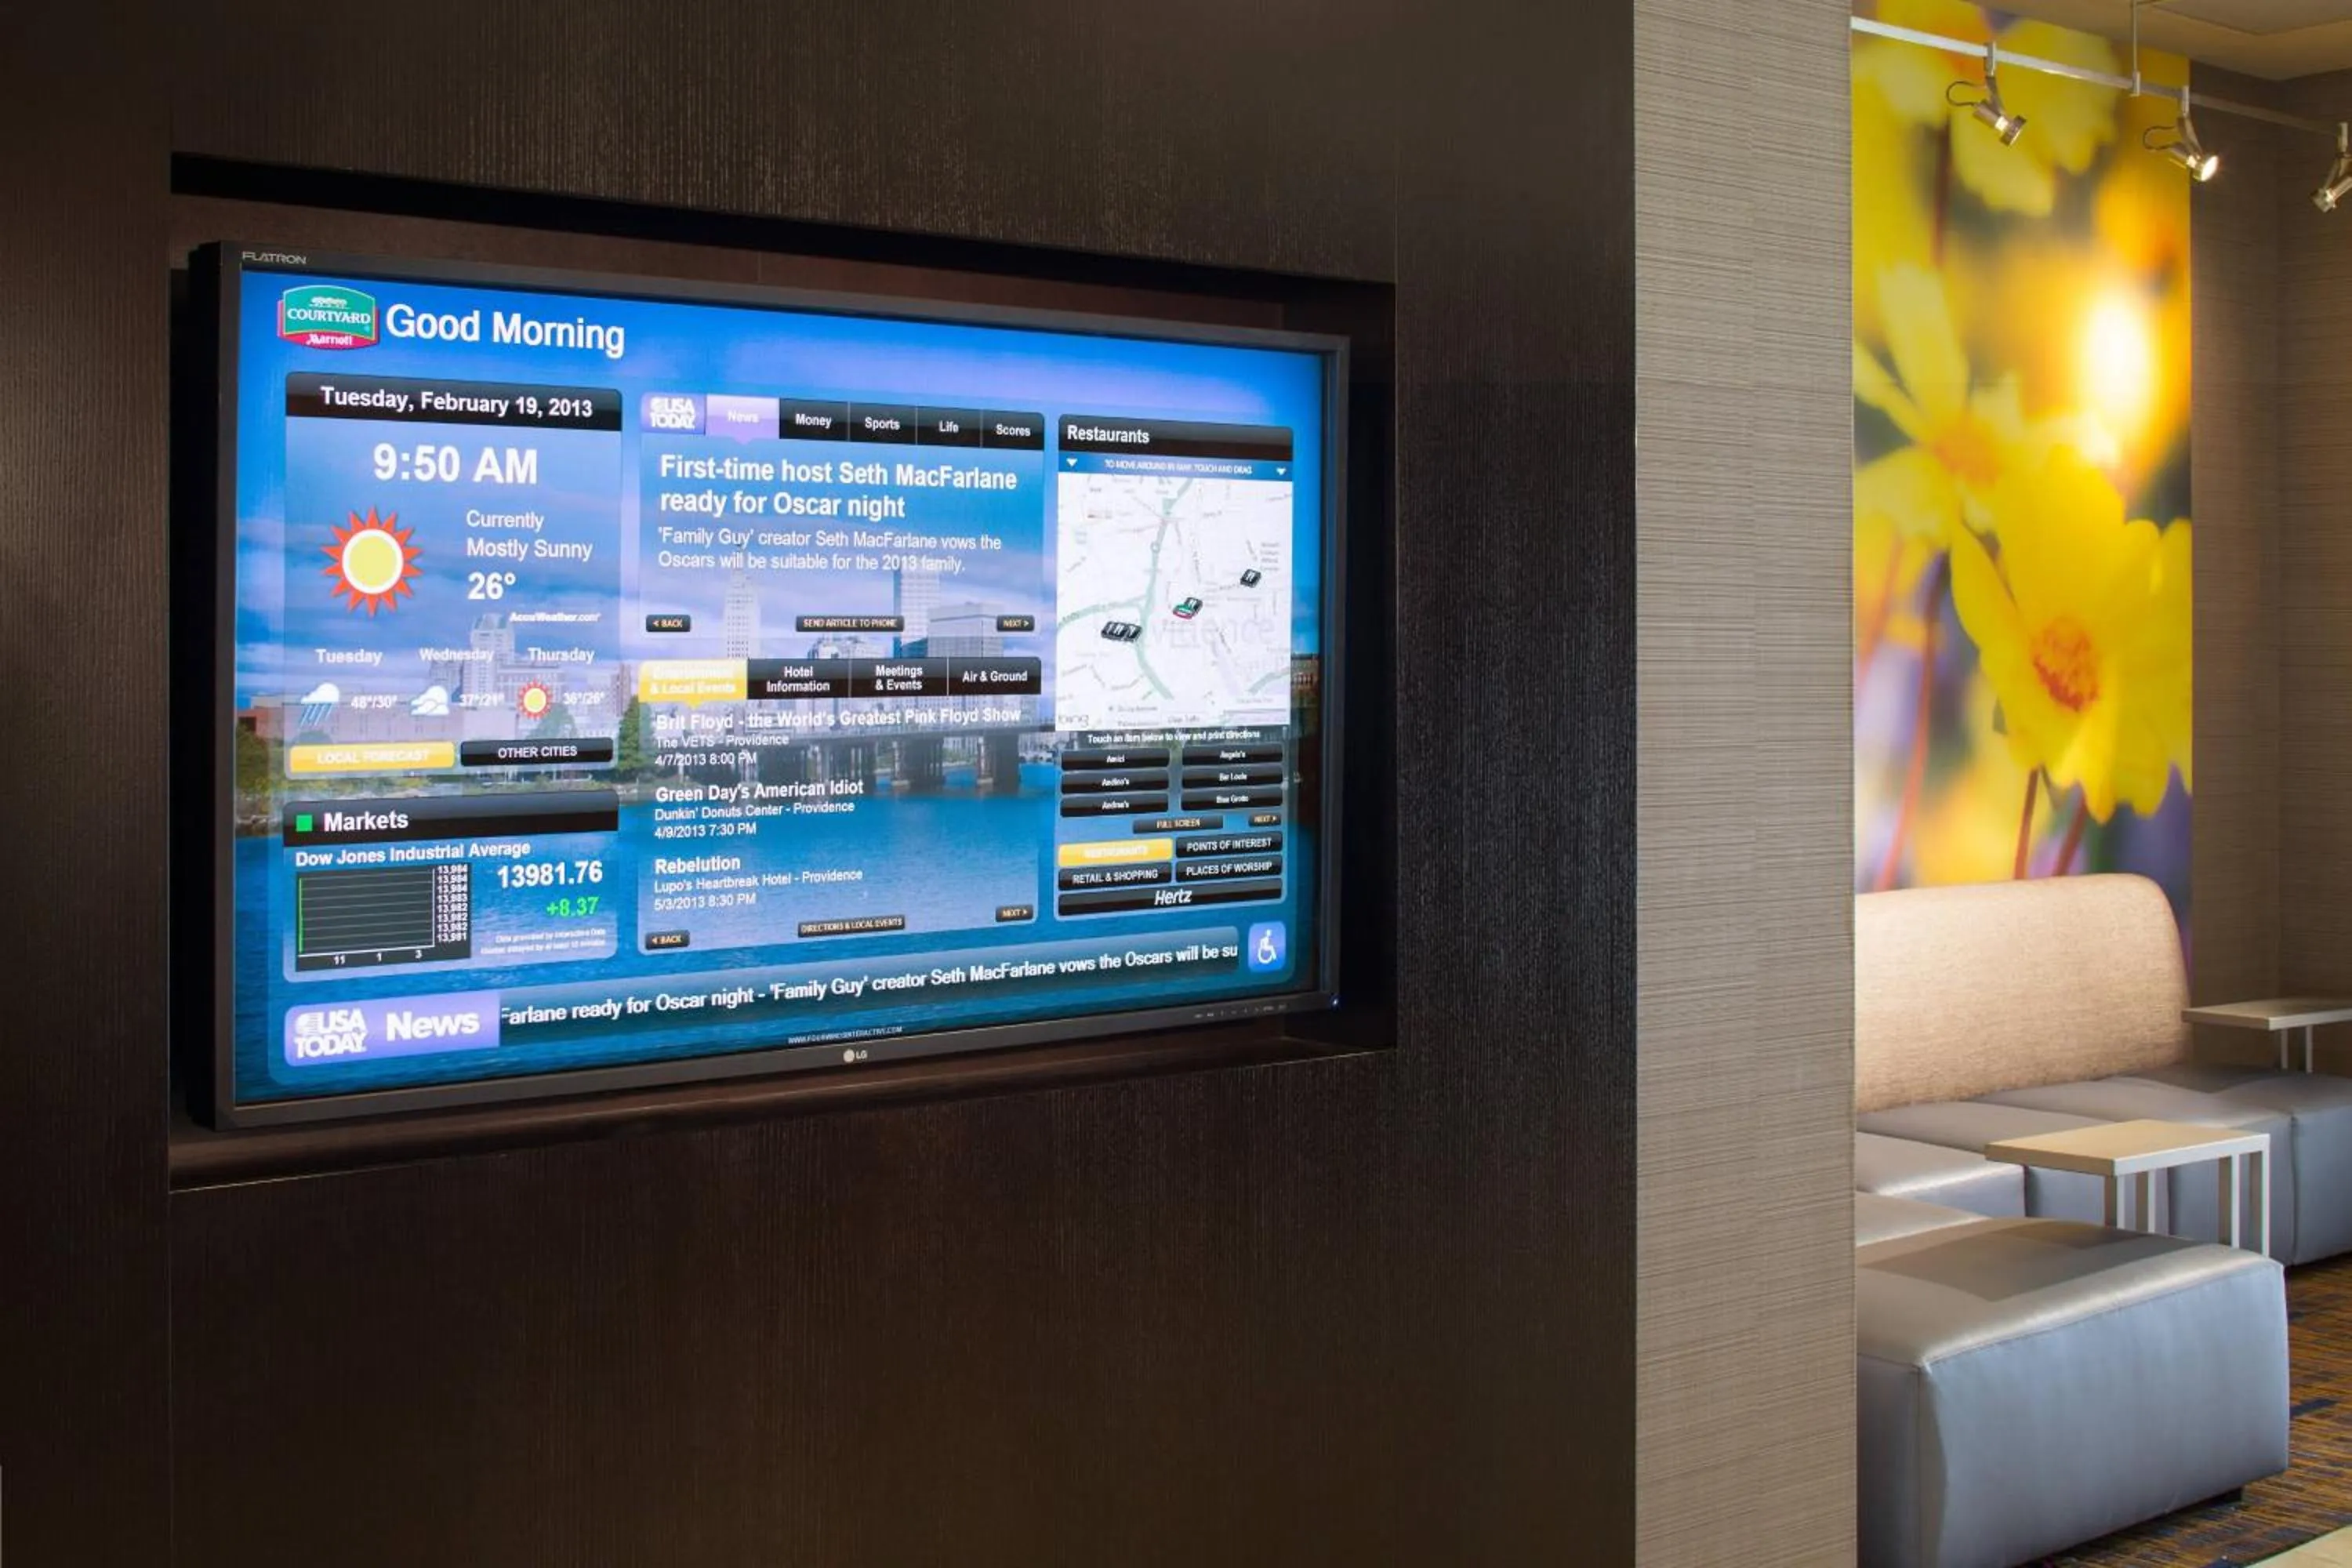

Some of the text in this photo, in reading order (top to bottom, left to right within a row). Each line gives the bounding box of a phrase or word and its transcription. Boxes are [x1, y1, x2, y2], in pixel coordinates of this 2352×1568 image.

[242, 252, 307, 264] FLATRON
[287, 309, 371, 324] COURTYARD
[387, 304, 625, 358] Good Morning
[321, 387, 593, 418] Tuesday, February 19, 2013
[666, 397, 695, 413] USA
[650, 412, 695, 429] TODAY
[728, 410, 758, 423] News
[796, 413, 832, 429] Money
[865, 417, 900, 431] Sports
[939, 421, 958, 433] Life
[996, 424, 1031, 437] Scores
[1067, 425, 1149, 444] Restaurants
[373, 444, 537, 484] 9:50 AM
[661, 456, 1017, 489] First-time host Seth MacFarlane
[661, 490, 906, 521] ready for Oscar night
[466, 510, 543, 532] Currently
[659, 527, 1001, 550] 'Family Guy' creator Seth MacFarlane vows the
[467, 539, 593, 561] Mostly Sunny
[659, 551, 965, 573] Oscars will be suitable for the 2013 family.
[468, 572, 516, 599] 26°
[662, 619, 682, 628] BACK
[1004, 619, 1022, 628] NEXT
[316, 648, 382, 666] Tuesday
[419, 648, 495, 663] Wednesday
[528, 648, 594, 665] Thursday
[785, 667, 813, 677] Hotel
[876, 665, 923, 678] Meetings
[963, 670, 1028, 682] Air & Ground
[767, 681, 829, 692] Information
[876, 678, 922, 691] & Events
[655, 707, 1021, 730] Brit Floyd the World's Greatest Pink Floyd Show
[658, 735, 789, 749] The VETS Providence
[1088, 734, 1112, 744] Touch
[318, 751, 360, 764] LOCAL
[499, 746, 577, 758] OTHER CITIES
[655, 753, 757, 766] 4/7/2013 8:00 PM
[656, 779, 864, 803] Green Day's American Idiot
[655, 800, 855, 821] Dunkin' Donuts Center Providence
[324, 811, 408, 832] Markets
[654, 822, 757, 839] 4/9/2013 7:30 PM
[1187, 838, 1272, 852] POINTS OF INTEREST
[296, 843, 530, 866] Dow Jones Industrial Average
[655, 855, 740, 874] Rebelution
[1186, 862, 1272, 876] PLACES OF WORSHIP
[498, 862, 602, 887] 13981.76
[654, 869, 862, 894] Lupo's Heartbreak Hotel Providence
[1073, 869, 1158, 884] RETAIL & SHOPPING
[654, 893, 756, 911] 5/3/2013 8:30 PM
[1155, 889, 1192, 905] Hertz
[546, 897, 598, 917] +8.37
[572, 1001, 621, 1021] ready
[626, 998, 650, 1013] for
[655, 993, 707, 1011] Oscar
[711, 988, 755, 1007] night
[770, 980, 826, 1001] 'Family
[832, 976, 869, 996] Guy'
[873, 972, 927, 991] creator
[931, 967, 966, 985] Seth
[970, 960, 1054, 982] MacFarlane
[1059, 957, 1096, 975] vows
[1099, 954, 1121, 969] the
[1125, 951, 1173, 967] Oscars
[1176, 946, 1199, 961] will
[1202, 944, 1218, 959] be
[1222, 946, 1238, 957] su
[321, 1009, 366, 1032] USA
[387, 1012, 481, 1041] News
[294, 1035, 366, 1058] TODAY
